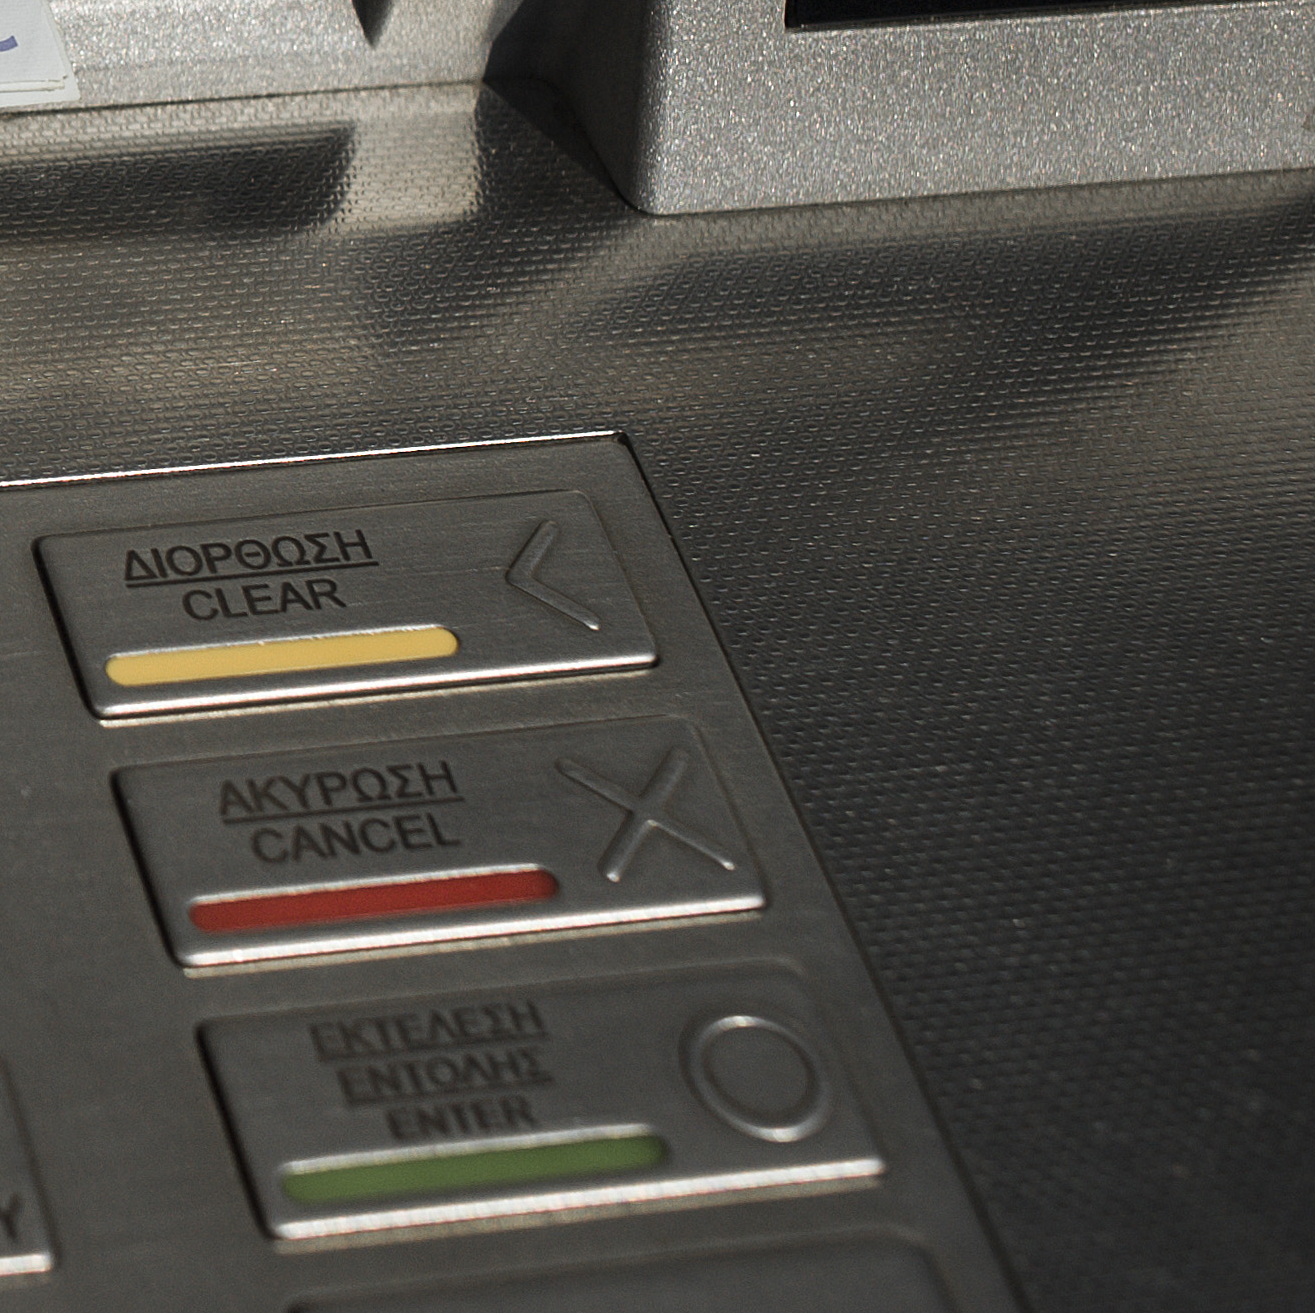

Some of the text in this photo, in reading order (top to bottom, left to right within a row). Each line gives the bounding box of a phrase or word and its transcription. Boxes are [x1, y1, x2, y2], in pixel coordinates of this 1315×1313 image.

[123, 528, 375, 581] ΔΙΟΡΘΩΣΗ
[180, 578, 346, 624] CLEAR
[219, 760, 459, 816] ΑΚΥΡΩΣΗ
[250, 813, 460, 865] CANCEL
[384, 1093, 539, 1140] ENTER
